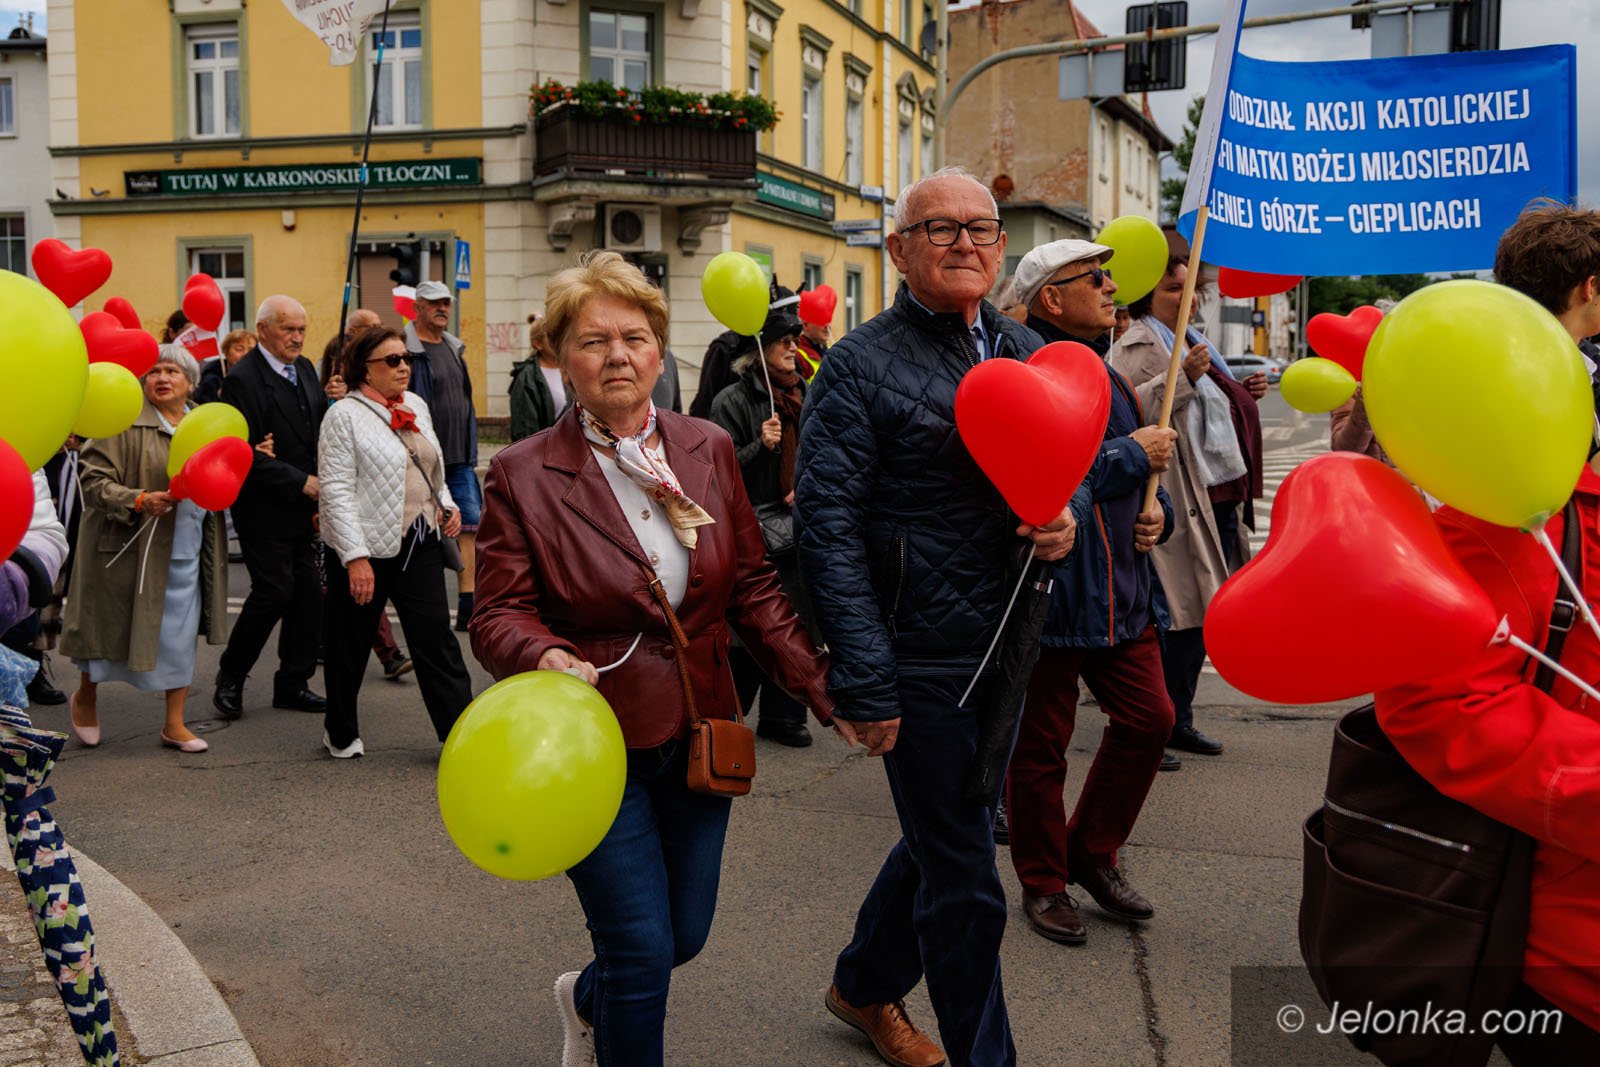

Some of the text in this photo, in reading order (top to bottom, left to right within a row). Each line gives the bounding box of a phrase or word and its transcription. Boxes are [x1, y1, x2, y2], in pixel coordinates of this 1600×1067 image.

[1229, 88, 1530, 131] ODDZIAŁ AKCJI KATOLICKIEJ
[168, 173, 218, 190] TUTAJ
[222, 172, 239, 187] W
[374, 164, 451, 183] TŁOCZNI
[1235, 144, 1289, 182] MATKI
[1292, 148, 1356, 183] BOŻEJ
[1361, 142, 1530, 182] MIŁOSIERDZIA
[1260, 197, 1322, 234] GÓRZE
[1348, 198, 1481, 234] CIEPLICACH
